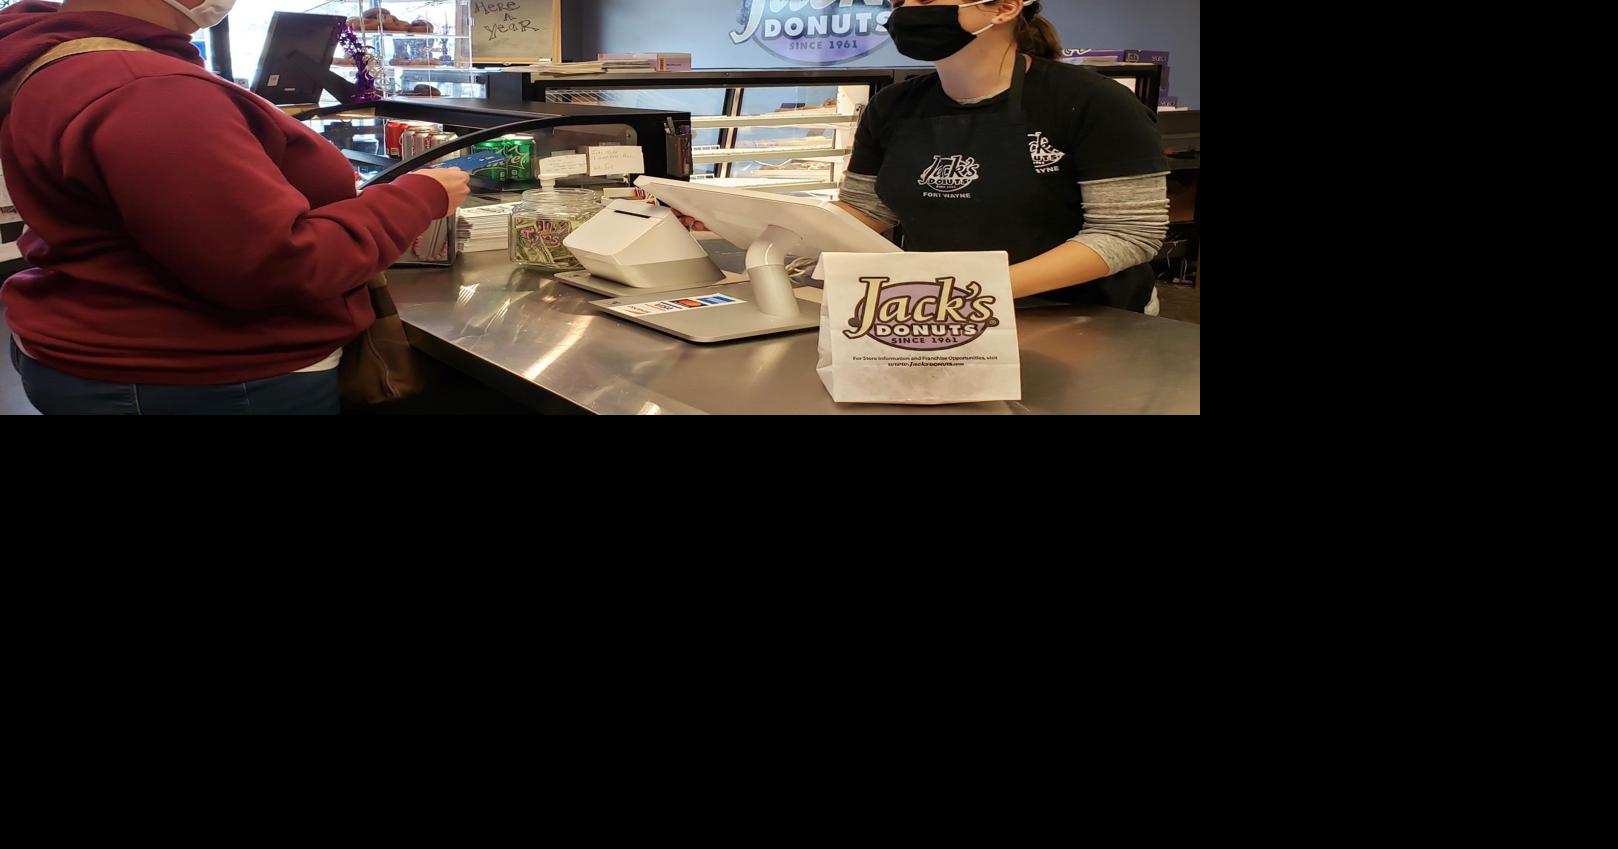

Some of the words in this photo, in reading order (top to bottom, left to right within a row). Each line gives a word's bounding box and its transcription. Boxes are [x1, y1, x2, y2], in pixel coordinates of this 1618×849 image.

[763, 11, 890, 38] DONUTS
[788, 41, 823, 51] SINCE
[828, 39, 859, 50] 1961
[842, 276, 997, 340] Jack's
[875, 322, 979, 338] DONUTS
[890, 336, 926, 345] SINCE
[931, 336, 959, 345] 1961
